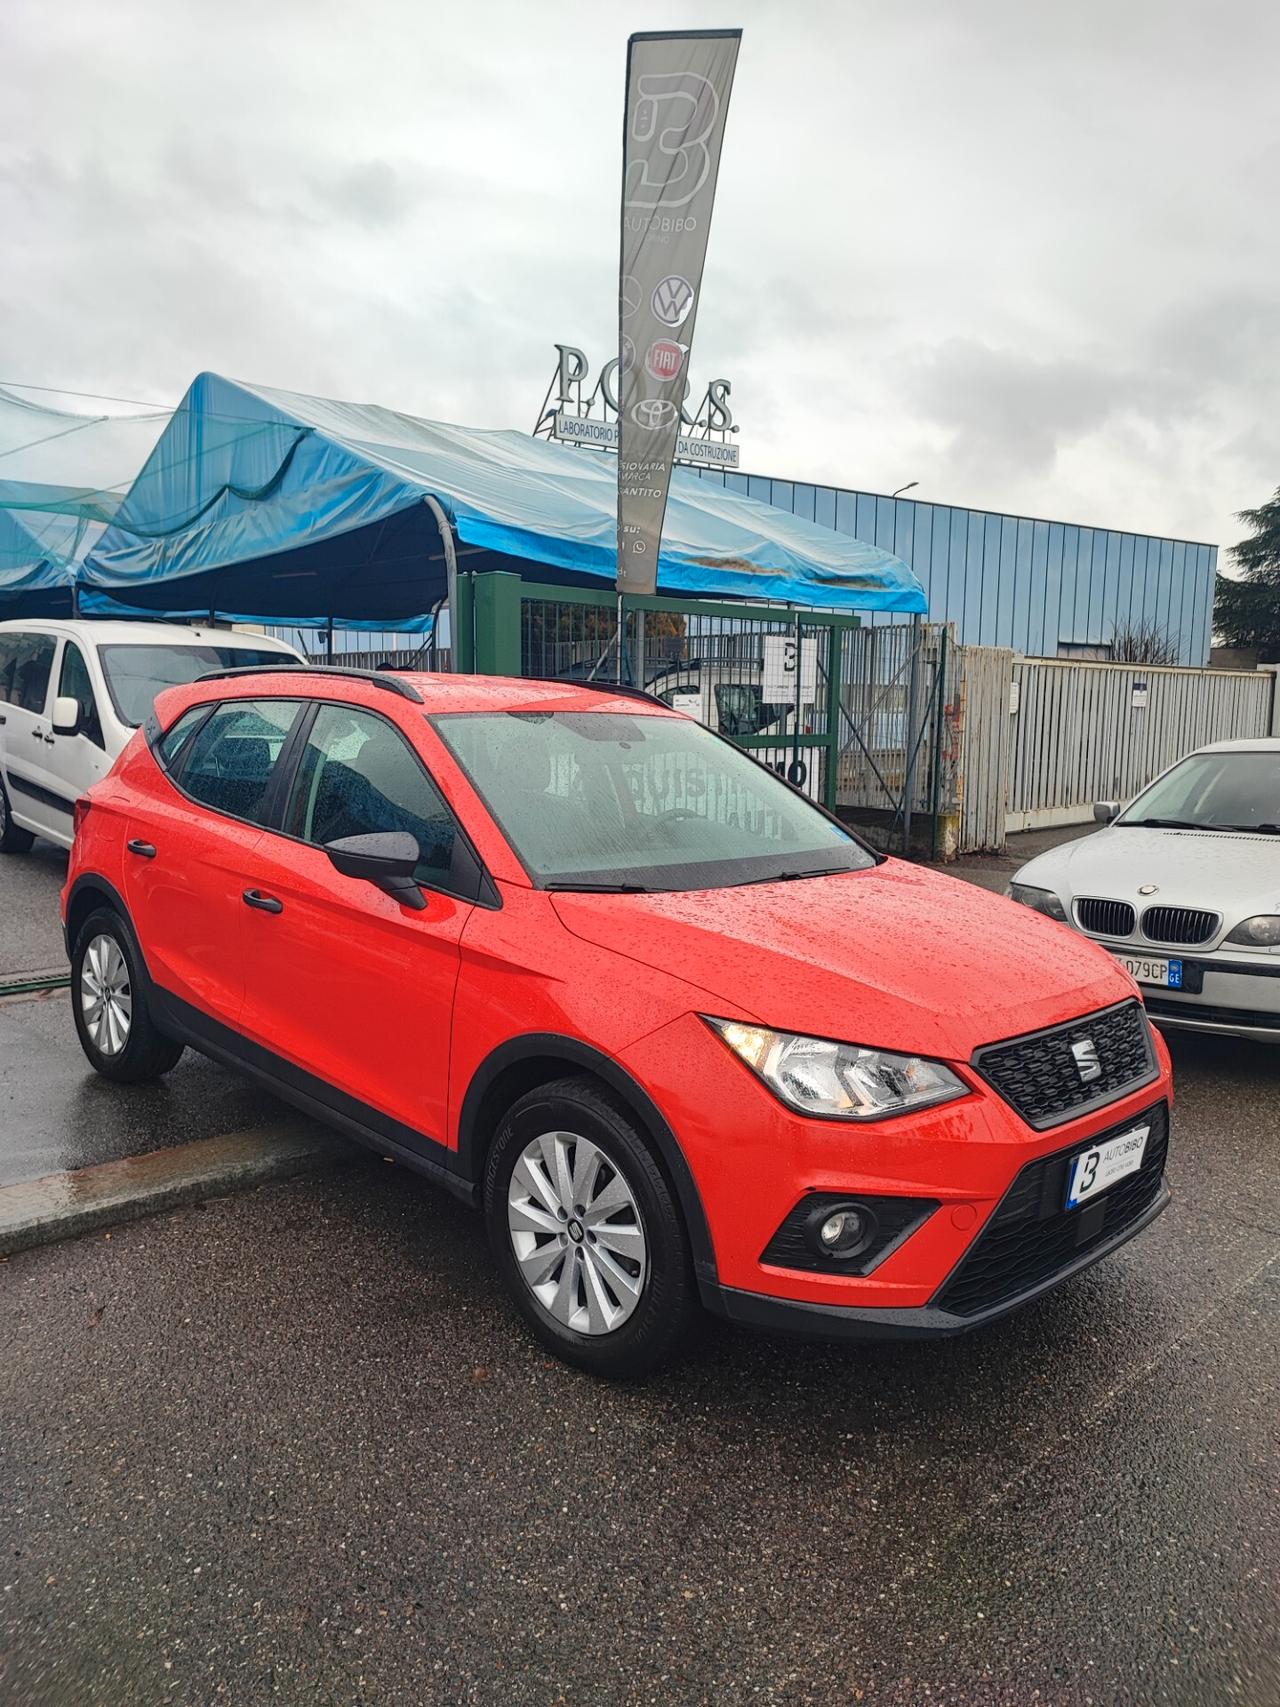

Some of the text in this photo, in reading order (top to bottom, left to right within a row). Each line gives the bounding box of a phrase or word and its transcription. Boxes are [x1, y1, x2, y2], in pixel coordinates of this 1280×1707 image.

[653, 349, 677, 372] FIAT
[559, 419, 613, 442] LABORATORIO
[678, 440, 689, 455] DA
[690, 442, 737, 463] COSTRUZIONE
[620, 487, 662, 498] ANTITO
[1169, 973, 1180, 984] GE
[1103, 1136, 1144, 1163] AUTOBIBO
